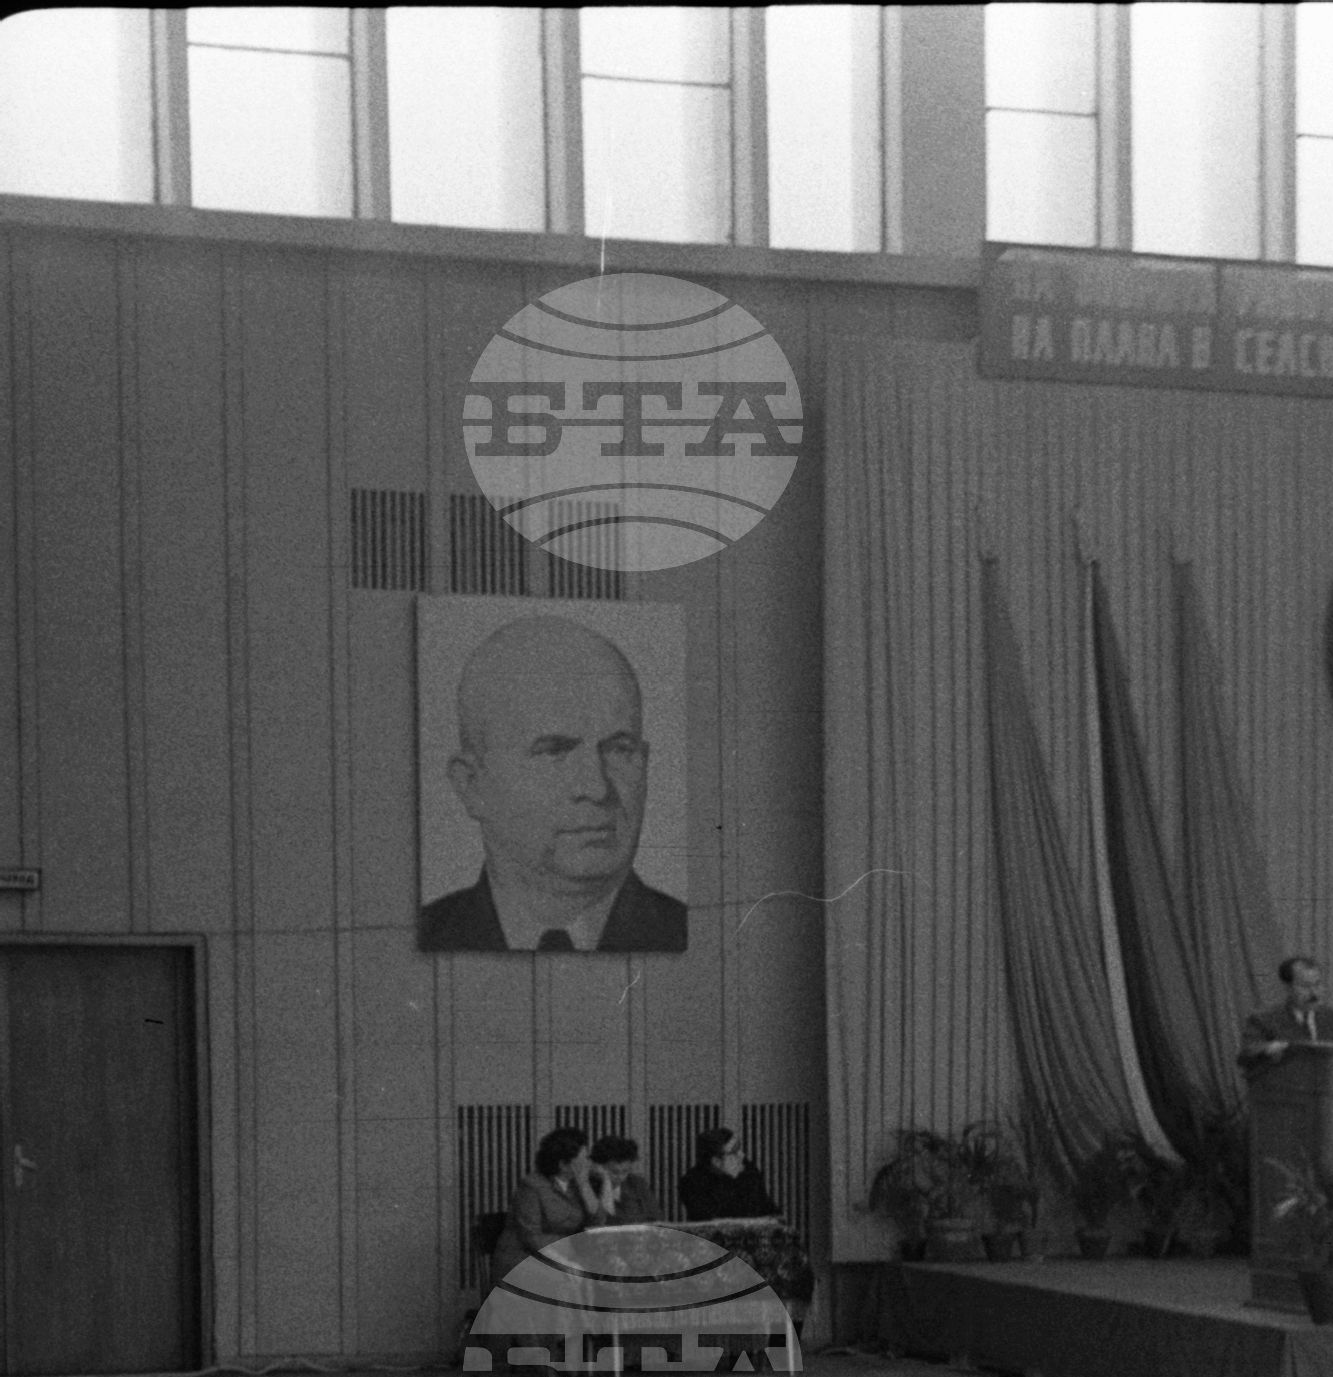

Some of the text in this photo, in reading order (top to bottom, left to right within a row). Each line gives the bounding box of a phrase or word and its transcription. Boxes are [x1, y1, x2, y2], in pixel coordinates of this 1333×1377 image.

[1011, 314, 1055, 361] НА
[1071, 317, 1180, 369] ПЛАНА
[1191, 326, 1211, 370] В
